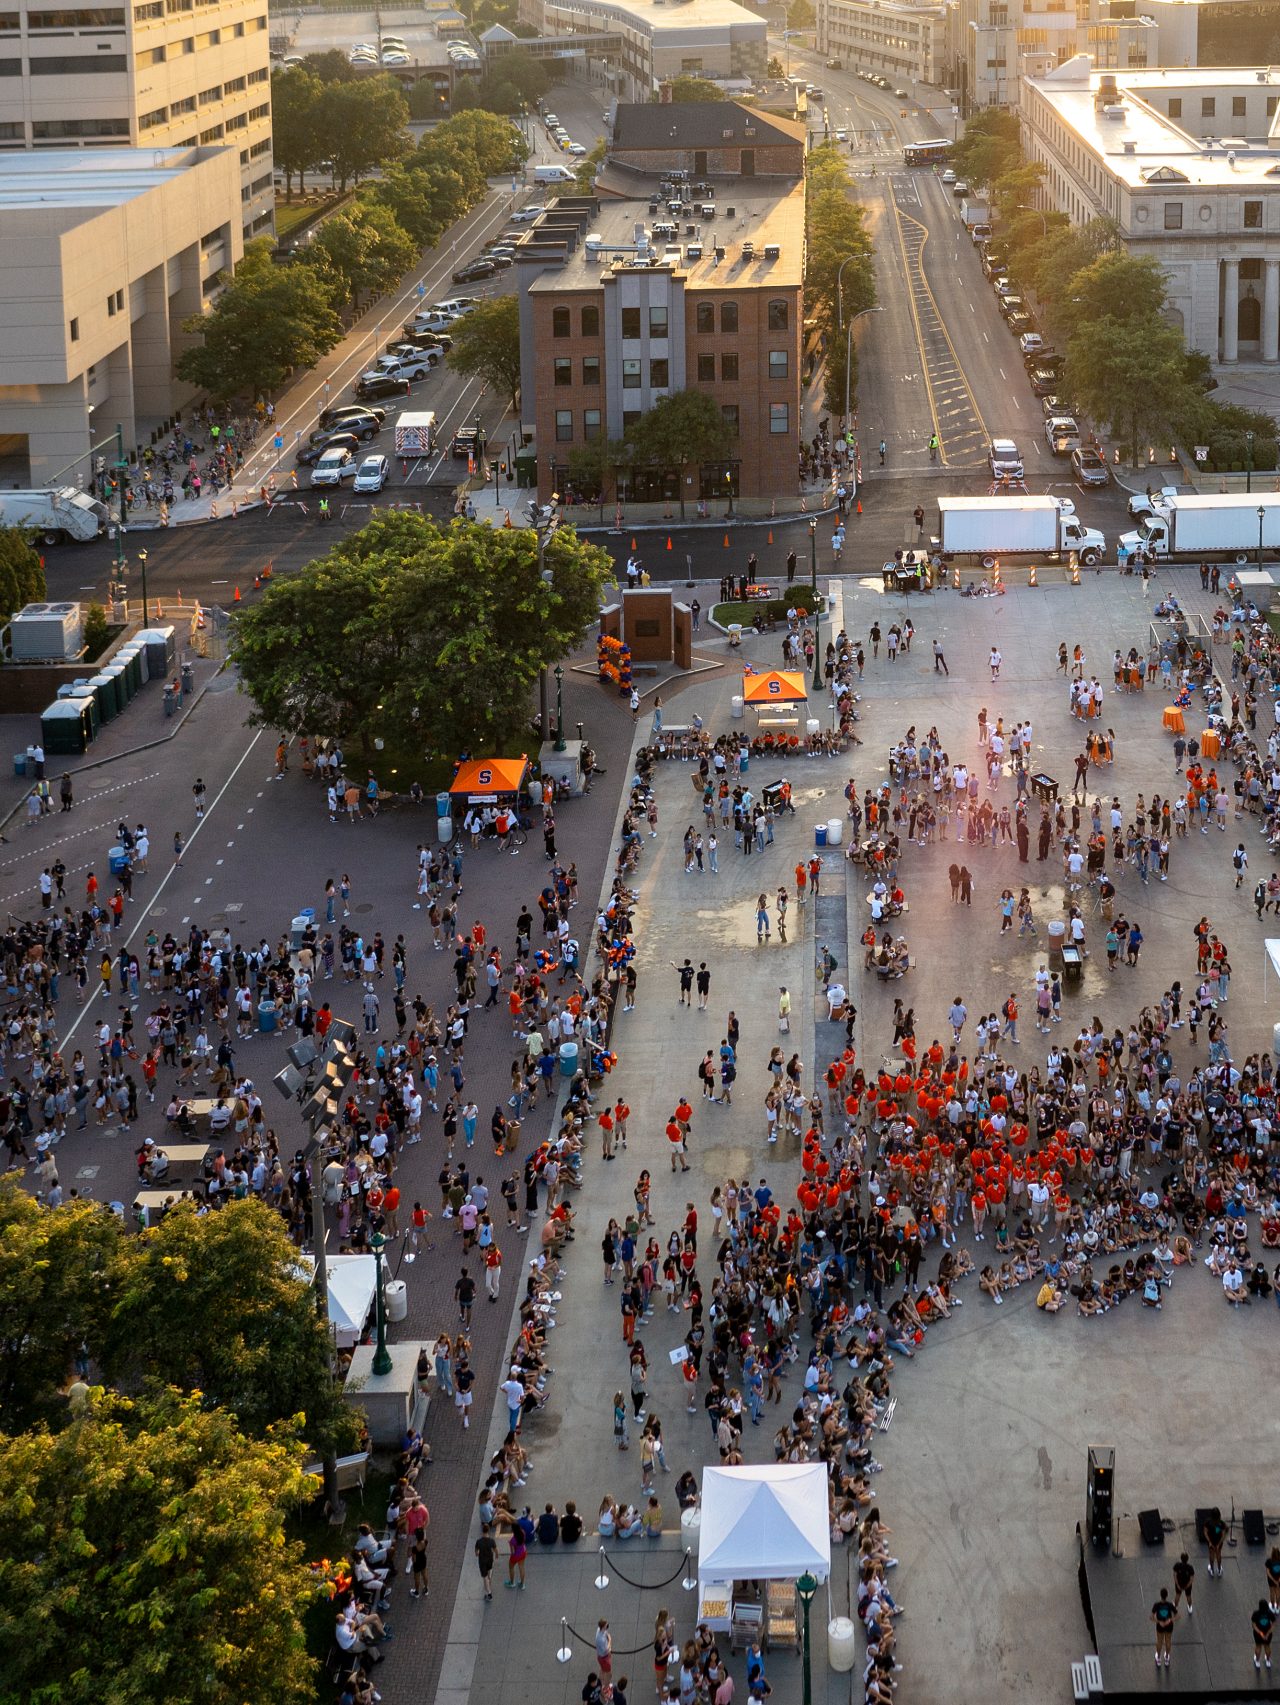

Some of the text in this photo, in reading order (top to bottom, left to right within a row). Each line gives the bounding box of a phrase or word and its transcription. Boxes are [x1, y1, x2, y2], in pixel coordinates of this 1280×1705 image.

[768, 681, 781, 694] S
[478, 769, 492, 785] S
[483, 1228, 488, 1237] 4
